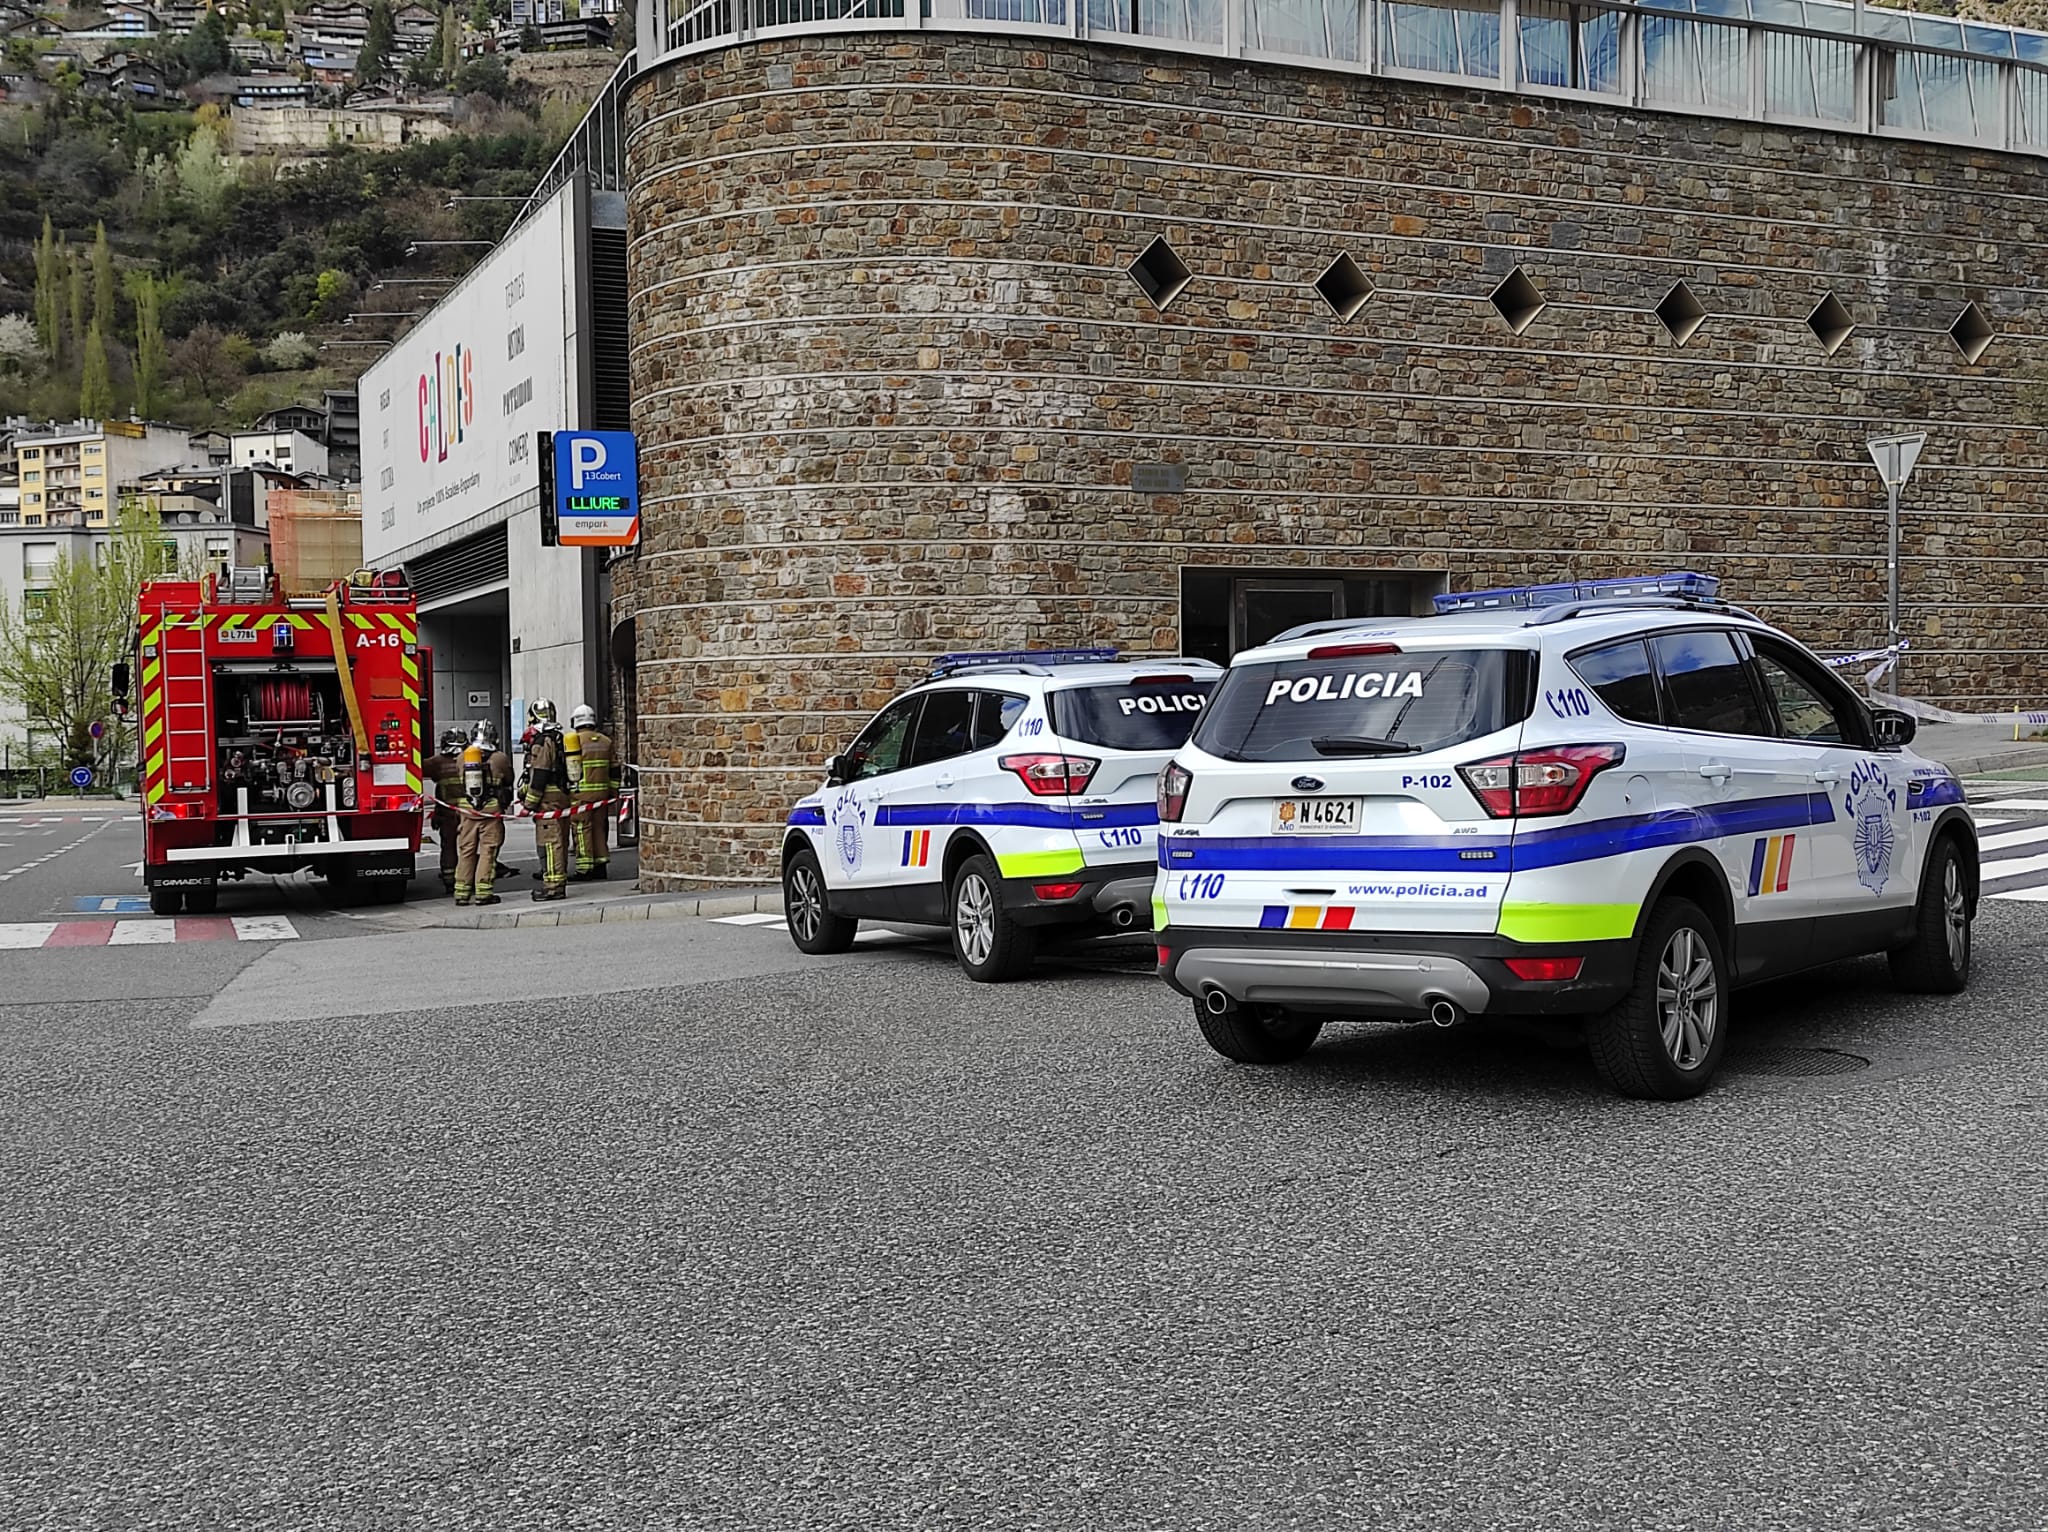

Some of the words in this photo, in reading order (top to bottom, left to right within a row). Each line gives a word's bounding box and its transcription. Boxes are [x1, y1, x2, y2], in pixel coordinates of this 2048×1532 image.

[418, 342, 473, 463] CALDES
[508, 431, 529, 465] COMERÇ
[571, 438, 607, 489] P
[571, 496, 621, 510] LLIURE
[575, 521, 609, 530] empark
[356, 633, 400, 647] A-16
[1265, 671, 1424, 706] POLICIA
[1118, 694, 1207, 715] POLICI
[1558, 688, 1590, 717] 110
[1024, 717, 1044, 737] 110
[1297, 779, 1317, 788] Ford
[1402, 775, 1453, 788] P-102
[1845, 758, 1897, 819] POLICIA
[832, 788, 867, 826] POLICIA
[1111, 828, 1142, 847] 110
[1191, 873, 1226, 899] 110
[1348, 883, 1488, 899] www.policia.ad
